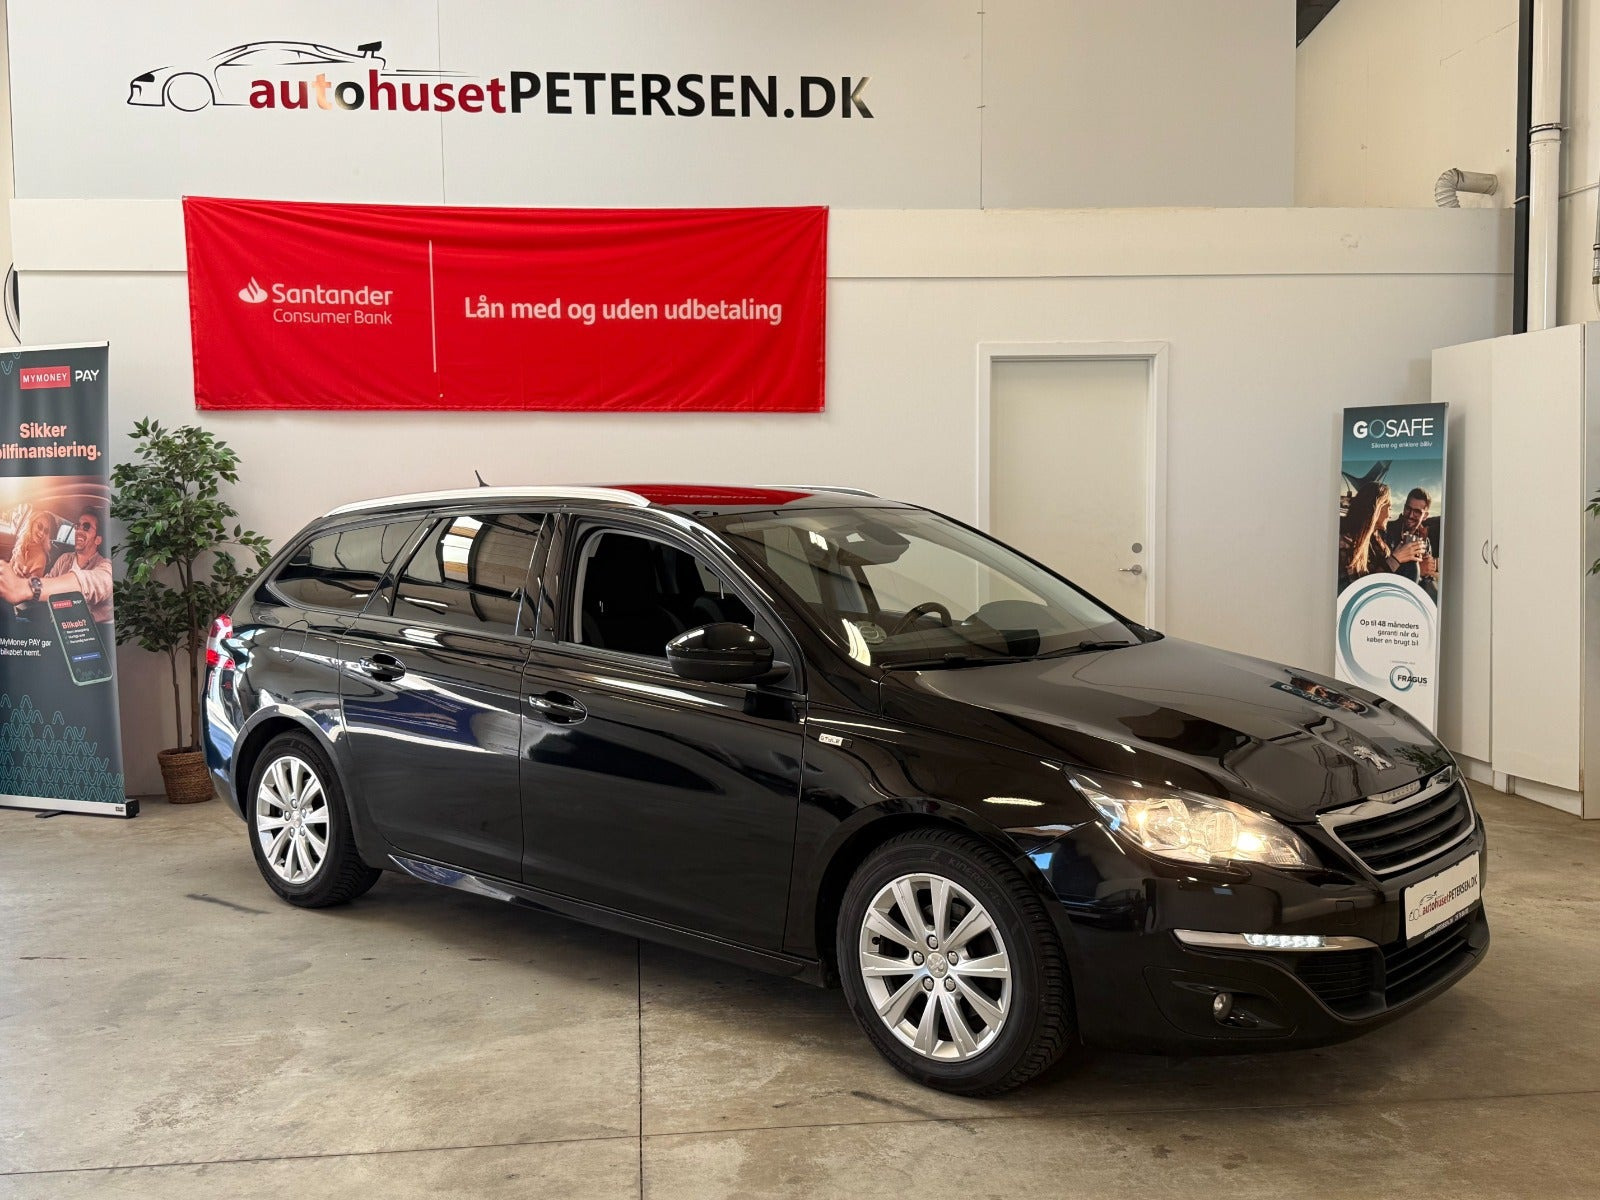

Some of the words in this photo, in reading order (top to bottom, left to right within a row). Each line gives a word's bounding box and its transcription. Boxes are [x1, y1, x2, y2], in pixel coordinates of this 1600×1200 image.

[250, 68, 875, 119] autohusetPETERSEN.DK
[272, 283, 393, 306] Santander
[273, 308, 350, 324] Consumer
[354, 309, 393, 325] Bank
[464, 295, 504, 319] Lån
[511, 298, 561, 320] med
[568, 302, 596, 326] og
[602, 298, 658, 321] uden
[665, 298, 783, 326] udbetaling
[22, 373, 68, 383] MYMONEY
[75, 369, 100, 382] PAY
[20, 422, 68, 439] Sikker
[1352, 417, 1434, 439] GOSAFE
[1390, 442, 1398, 450] og
[1377, 619, 1386, 627] 48
[1387, 620, 1420, 630] måneders
[1399, 629, 1410, 637] når
[1410, 631, 1419, 639] du
[28, 638, 41, 647] PAY
[1393, 638, 1410, 647] brugt
[1397, 674, 1428, 685] FRAGUS
